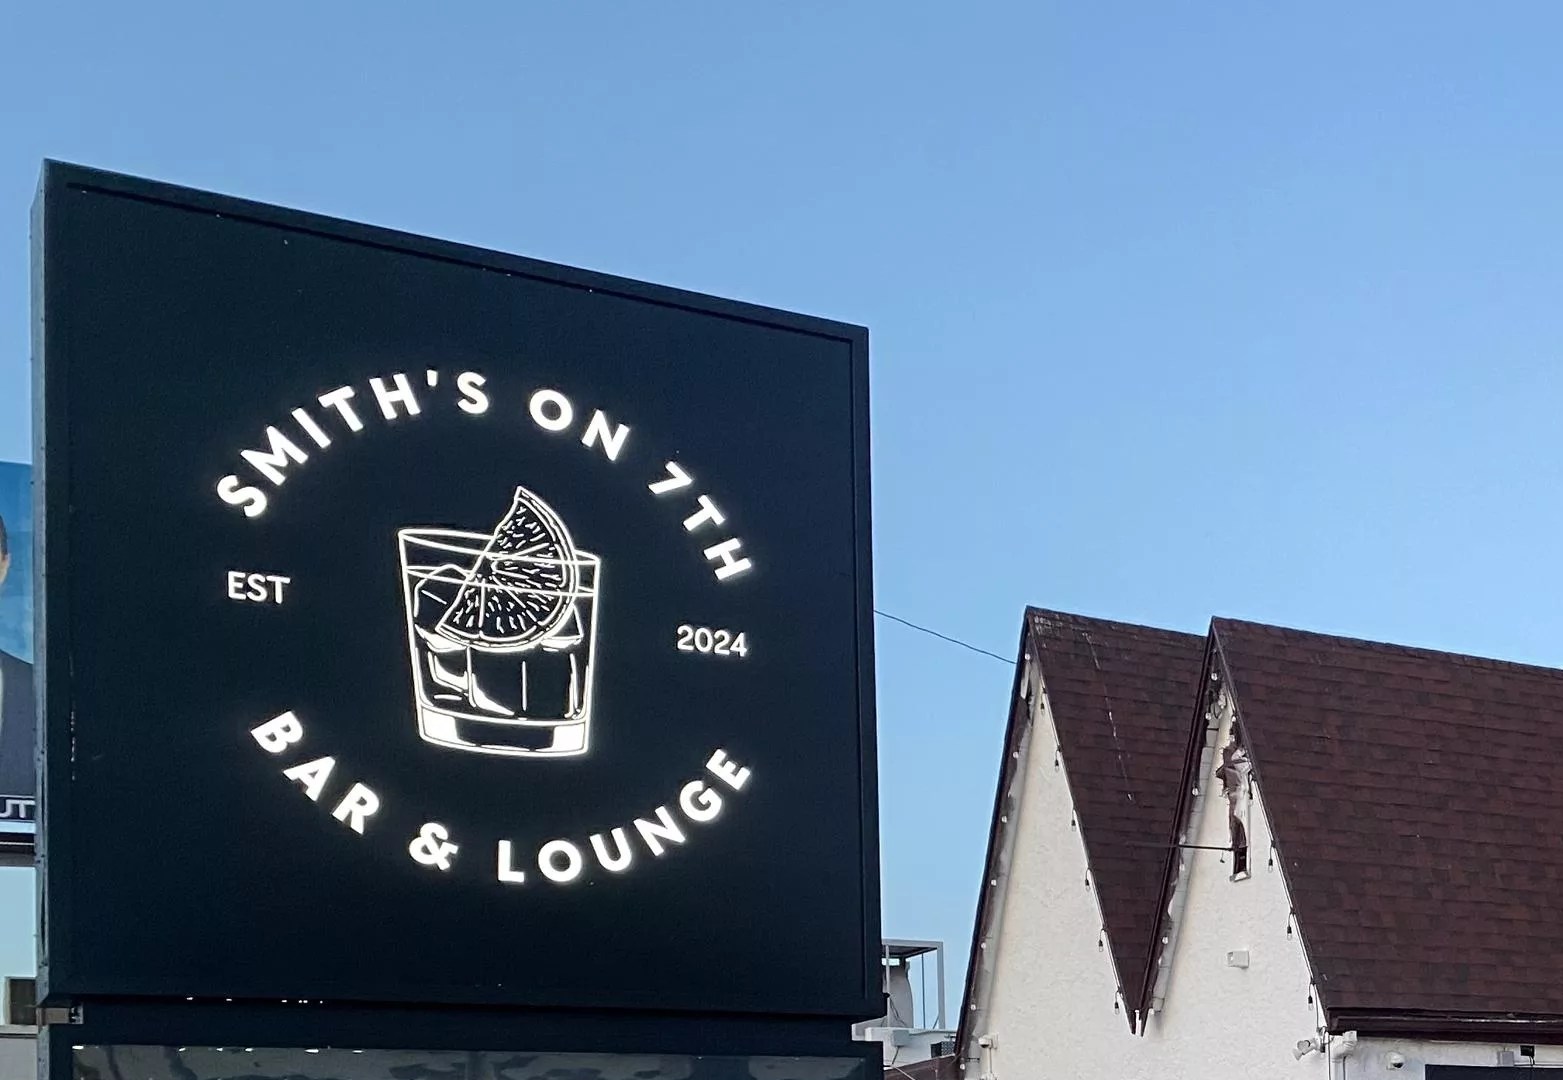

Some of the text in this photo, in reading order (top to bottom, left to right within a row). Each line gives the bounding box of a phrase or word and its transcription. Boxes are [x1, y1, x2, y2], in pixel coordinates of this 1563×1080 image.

[216, 369, 754, 582] SMITH'S ON 7TH
[227, 570, 291, 604] EST
[677, 624, 748, 658] 2024
[250, 710, 753, 885] BAR & LOUNGE
